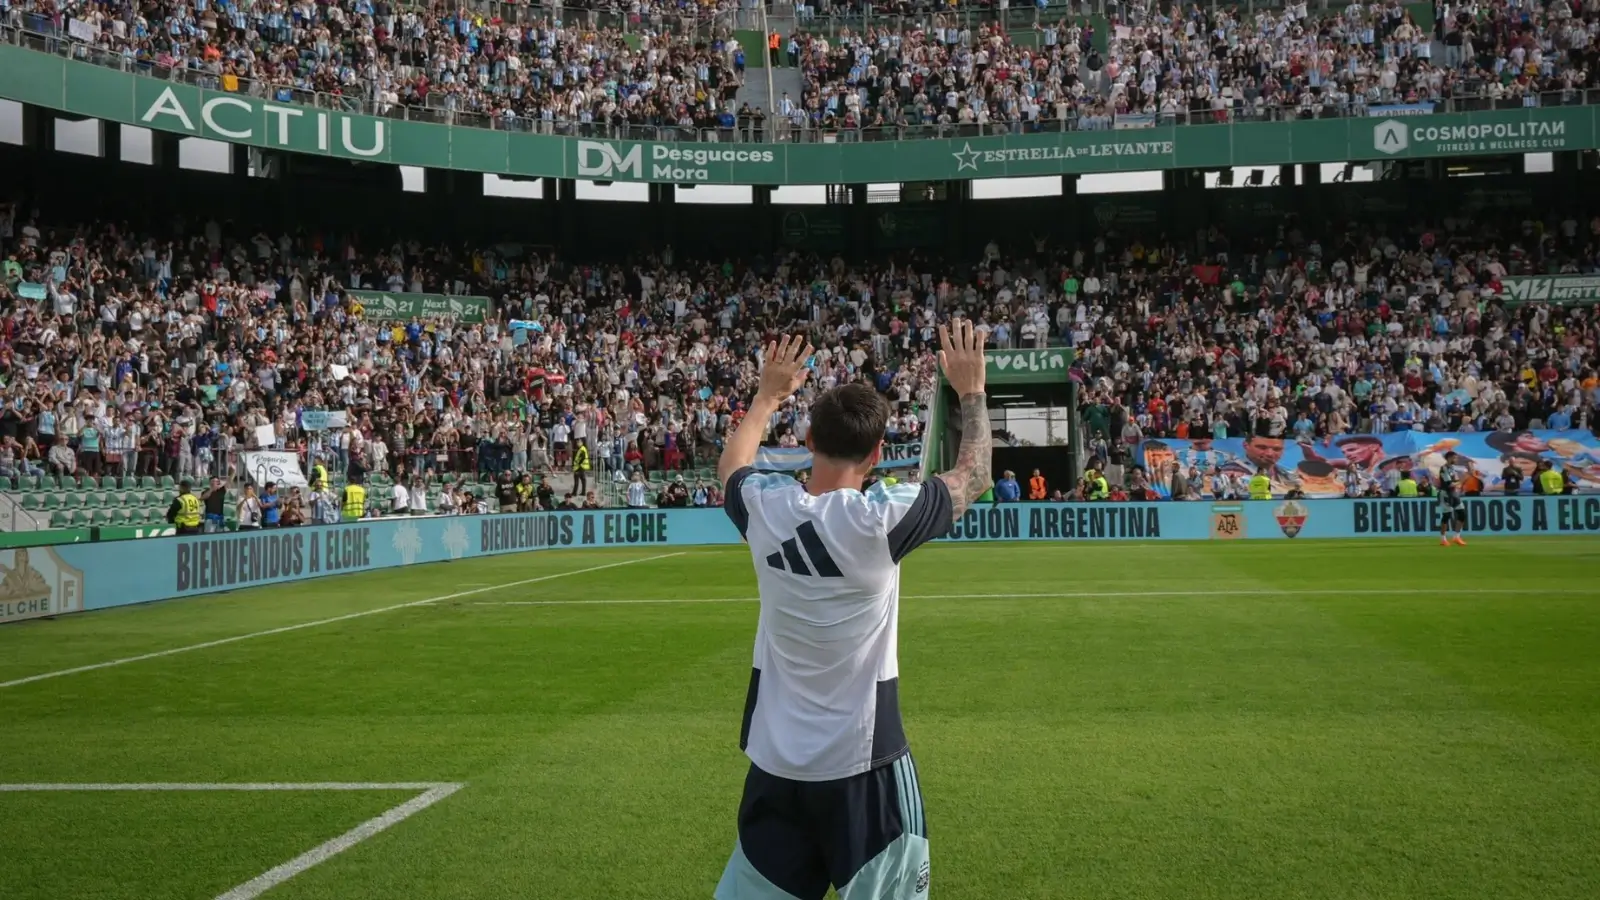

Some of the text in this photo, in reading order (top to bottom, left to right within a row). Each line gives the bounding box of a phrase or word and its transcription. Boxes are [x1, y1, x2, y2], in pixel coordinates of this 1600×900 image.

[142, 86, 384, 156] ACTIU
[653, 145, 774, 165] Desguaces
[984, 146, 1076, 163] ESTRELLA
[1090, 141, 1173, 157] LEVANTE
[1437, 138, 1565, 152] FITNESS & WELLNESS CLUB
[577, 140, 642, 178] DM
[653, 164, 708, 180] Mora
[356, 295, 380, 305] Next
[398, 302, 413, 313] 21
[423, 299, 447, 309] Next
[464, 304, 480, 316] 21
[363, 307, 393, 317] ergía
[935, 503, 1160, 539] CCIÓN ARGENTINA
[1354, 501, 1521, 533] BIENVEIDOS
[1532, 500, 1548, 531] A
[480, 512, 667, 551] BIENVENIDOS A ELCHE
[177, 528, 370, 592] BIENVENIDOS A ELCHE
